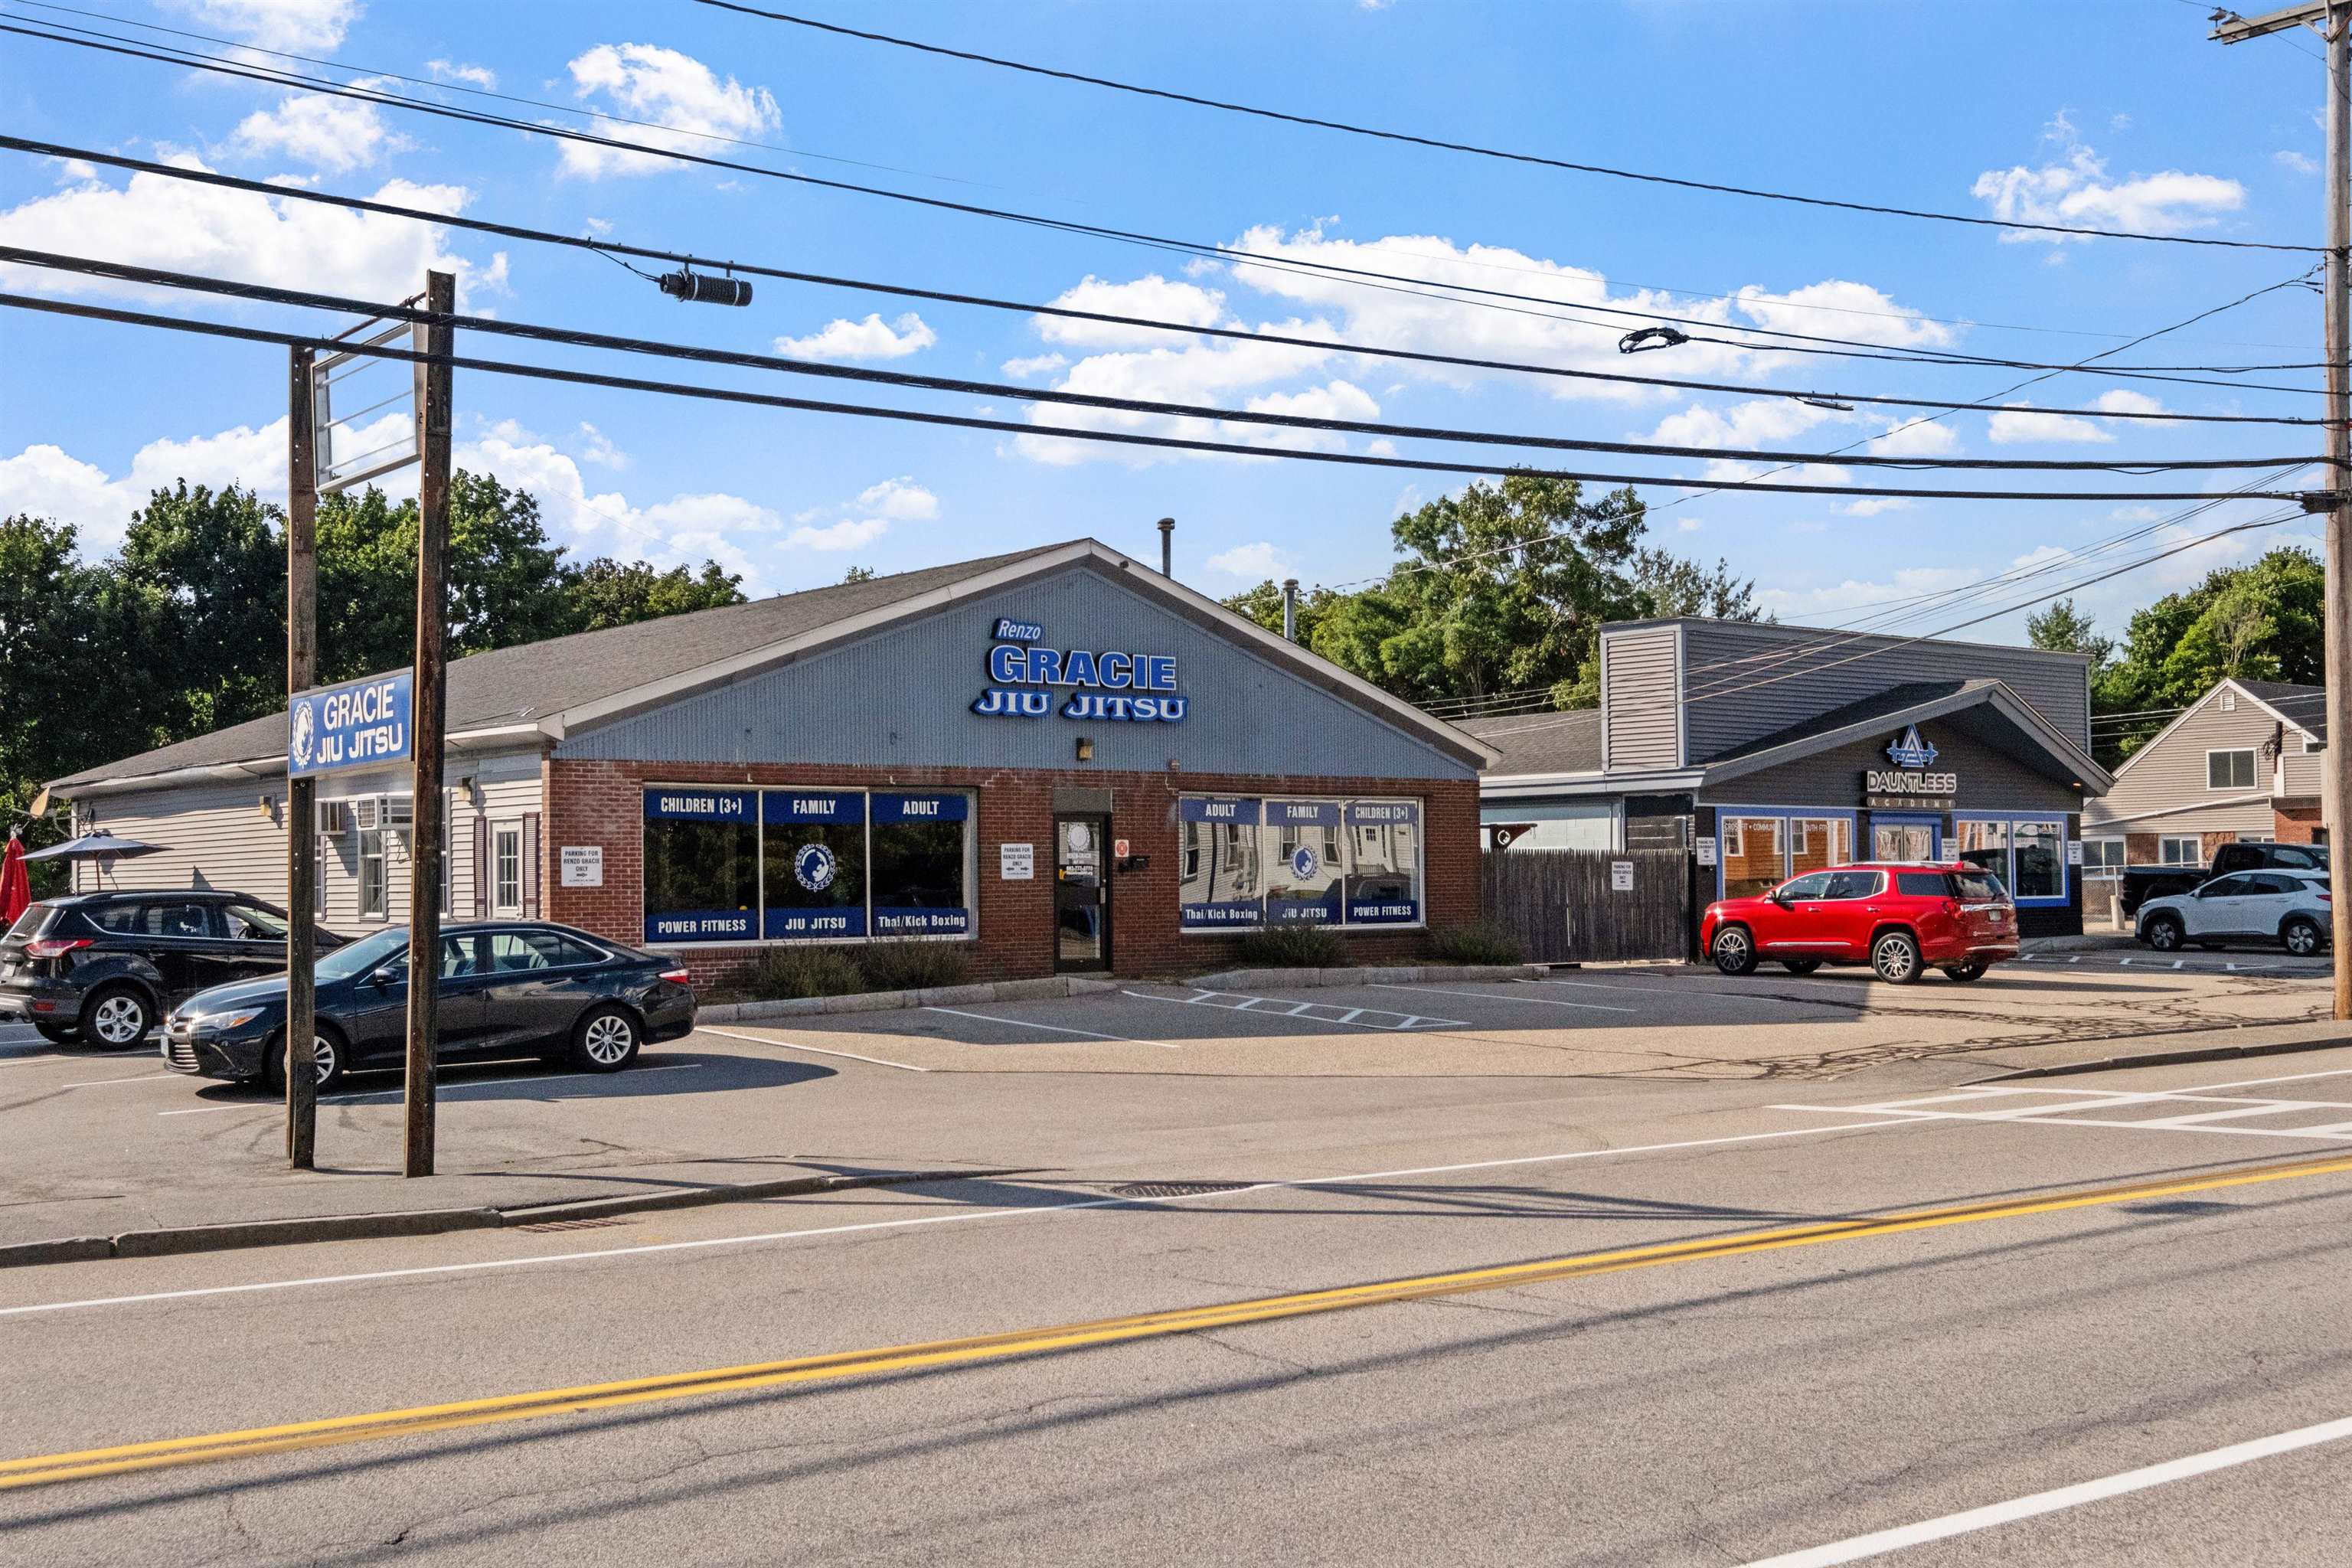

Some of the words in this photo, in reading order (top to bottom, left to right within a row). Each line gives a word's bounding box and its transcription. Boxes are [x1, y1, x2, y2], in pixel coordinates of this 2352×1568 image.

[998, 619, 1041, 639] Renzo
[991, 645, 1177, 691] GRACIE
[323, 682, 396, 730] GRACIE
[977, 691, 1050, 714] JIU
[1067, 695, 1185, 720] JITSU
[316, 734, 343, 764] JIU
[348, 723, 403, 759] JITSU
[1867, 770, 1957, 794] DAUNTLESS
[661, 797, 715, 813] CHILDREN
[719, 797, 743, 815] (3+)
[792, 799, 836, 815] FAMILY
[903, 801, 940, 815] ADULT
[1870, 798, 1952, 808] ACADEMY
[1205, 803, 1236, 818] ADULT
[1287, 805, 1319, 818] FAMILY
[1354, 806, 1391, 819] CHILDREN
[1393, 806, 1409, 820] (3+)
[1185, 908, 1226, 920] Thai/Kick
[1230, 908, 1258, 920] Boxing
[1282, 907, 1297, 918] JIU
[1301, 907, 1328, 918] JITSU
[1354, 906, 1379, 917] POWER
[1382, 905, 1412, 916] FITNESS
[658, 921, 697, 933] POWER
[701, 920, 746, 932] FITNESS
[785, 918, 805, 930] JIU
[811, 917, 847, 929] JITSU
[878, 915, 927, 927] Thai/Kick
[931, 914, 966, 927] Boxing
